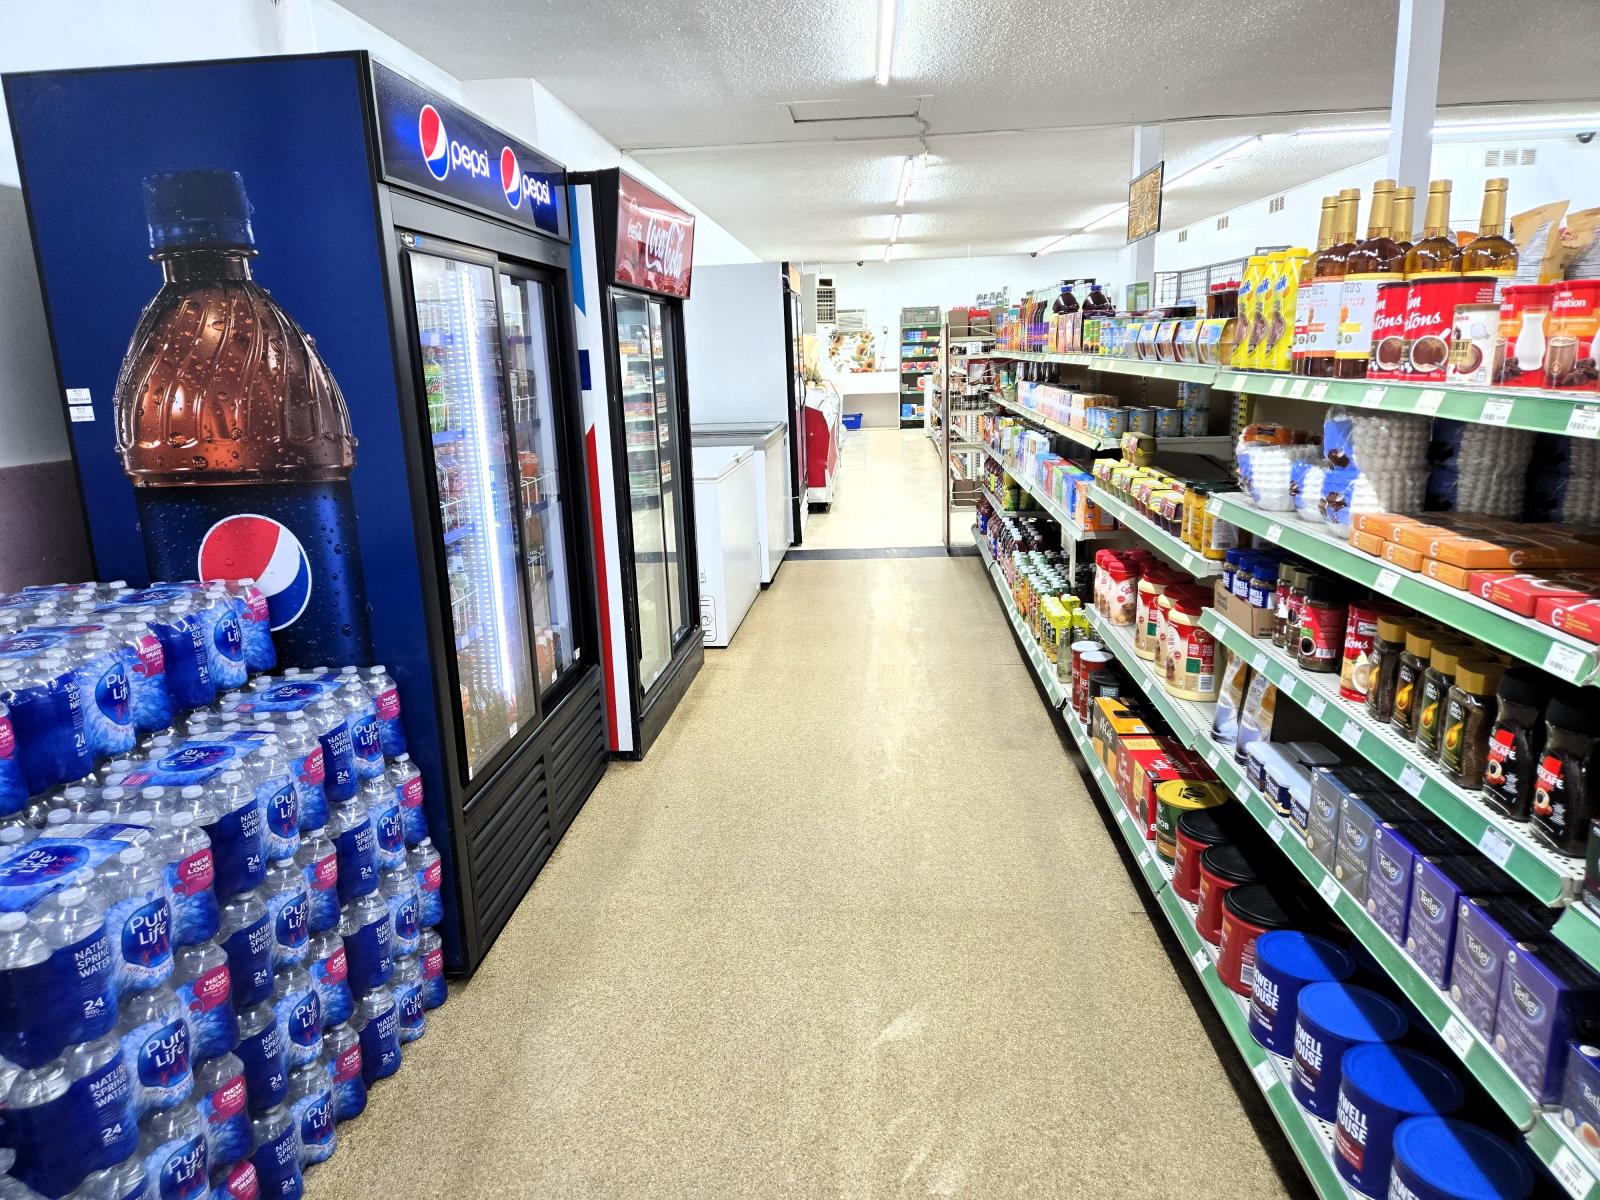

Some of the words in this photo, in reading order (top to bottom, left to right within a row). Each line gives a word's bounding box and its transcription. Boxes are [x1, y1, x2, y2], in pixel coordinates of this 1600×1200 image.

[451, 139, 491, 179] pepsi
[523, 172, 551, 206] pepsi
[75, 733, 85, 747] 24
[337, 770, 349, 779] 24
[1316, 792, 1330, 817] Tetley
[1346, 822, 1362, 846] Tetley
[190, 855, 209, 868] NEW
[246, 855, 259, 867] 24
[360, 867, 372, 876] 24
[1379, 852, 1399, 880] Tetley
[1420, 888, 1441, 918] Tetley
[130, 903, 169, 934] Pure
[139, 920, 167, 946] Life
[1467, 933, 1491, 966] Tetley
[79, 958, 111, 979] WATER
[380, 958, 390, 967] 24
[205, 971, 225, 985] NEW
[254, 969, 268, 981] 24
[83, 996, 105, 1012] 24
[1513, 979, 1538, 1017] Tetley
[145, 1025, 186, 1060] Pure
[155, 1042, 185, 1068] Life
[382, 1051, 395, 1061] 24
[91, 1073, 128, 1100] SPRING
[223, 1081, 242, 1096] NEW
[270, 1073, 282, 1085] 24
[94, 1086, 129, 1108] WATER
[102, 1122, 122, 1139] 24
[166, 1139, 206, 1175] Pure
[176, 1156, 204, 1184] Life
[281, 1177, 295, 1189] 24
